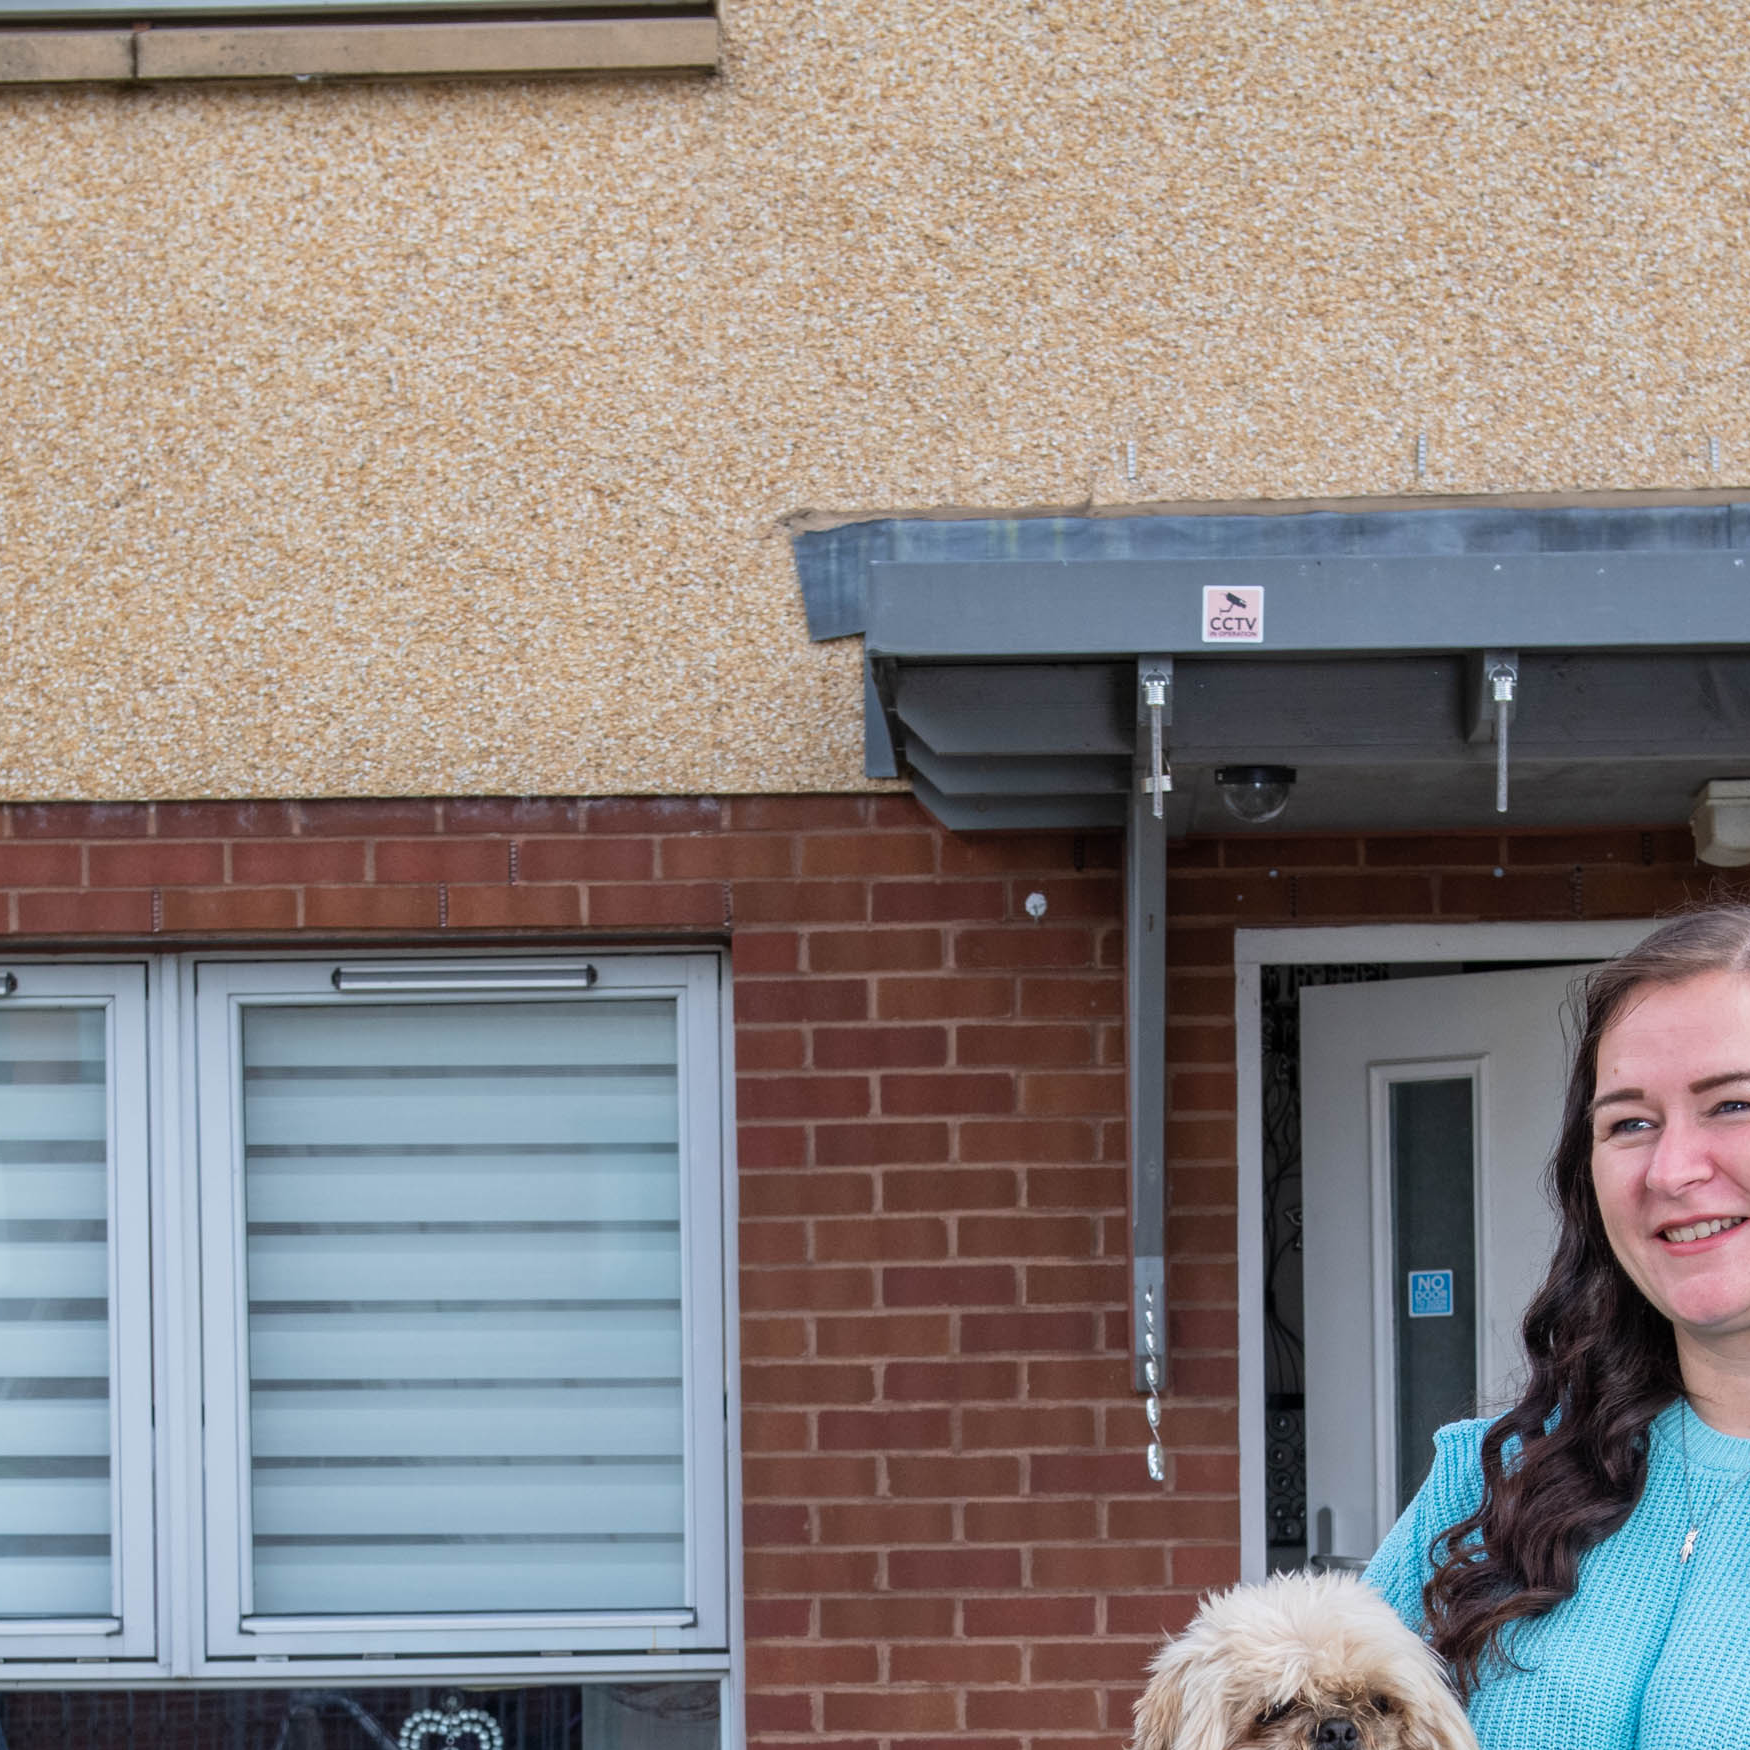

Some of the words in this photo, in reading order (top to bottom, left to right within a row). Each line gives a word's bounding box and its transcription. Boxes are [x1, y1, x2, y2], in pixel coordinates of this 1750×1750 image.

[1210, 616, 1257, 631] CCTV
[1418, 1276, 1444, 1290] NO
[1415, 1290, 1448, 1300] DOOR
